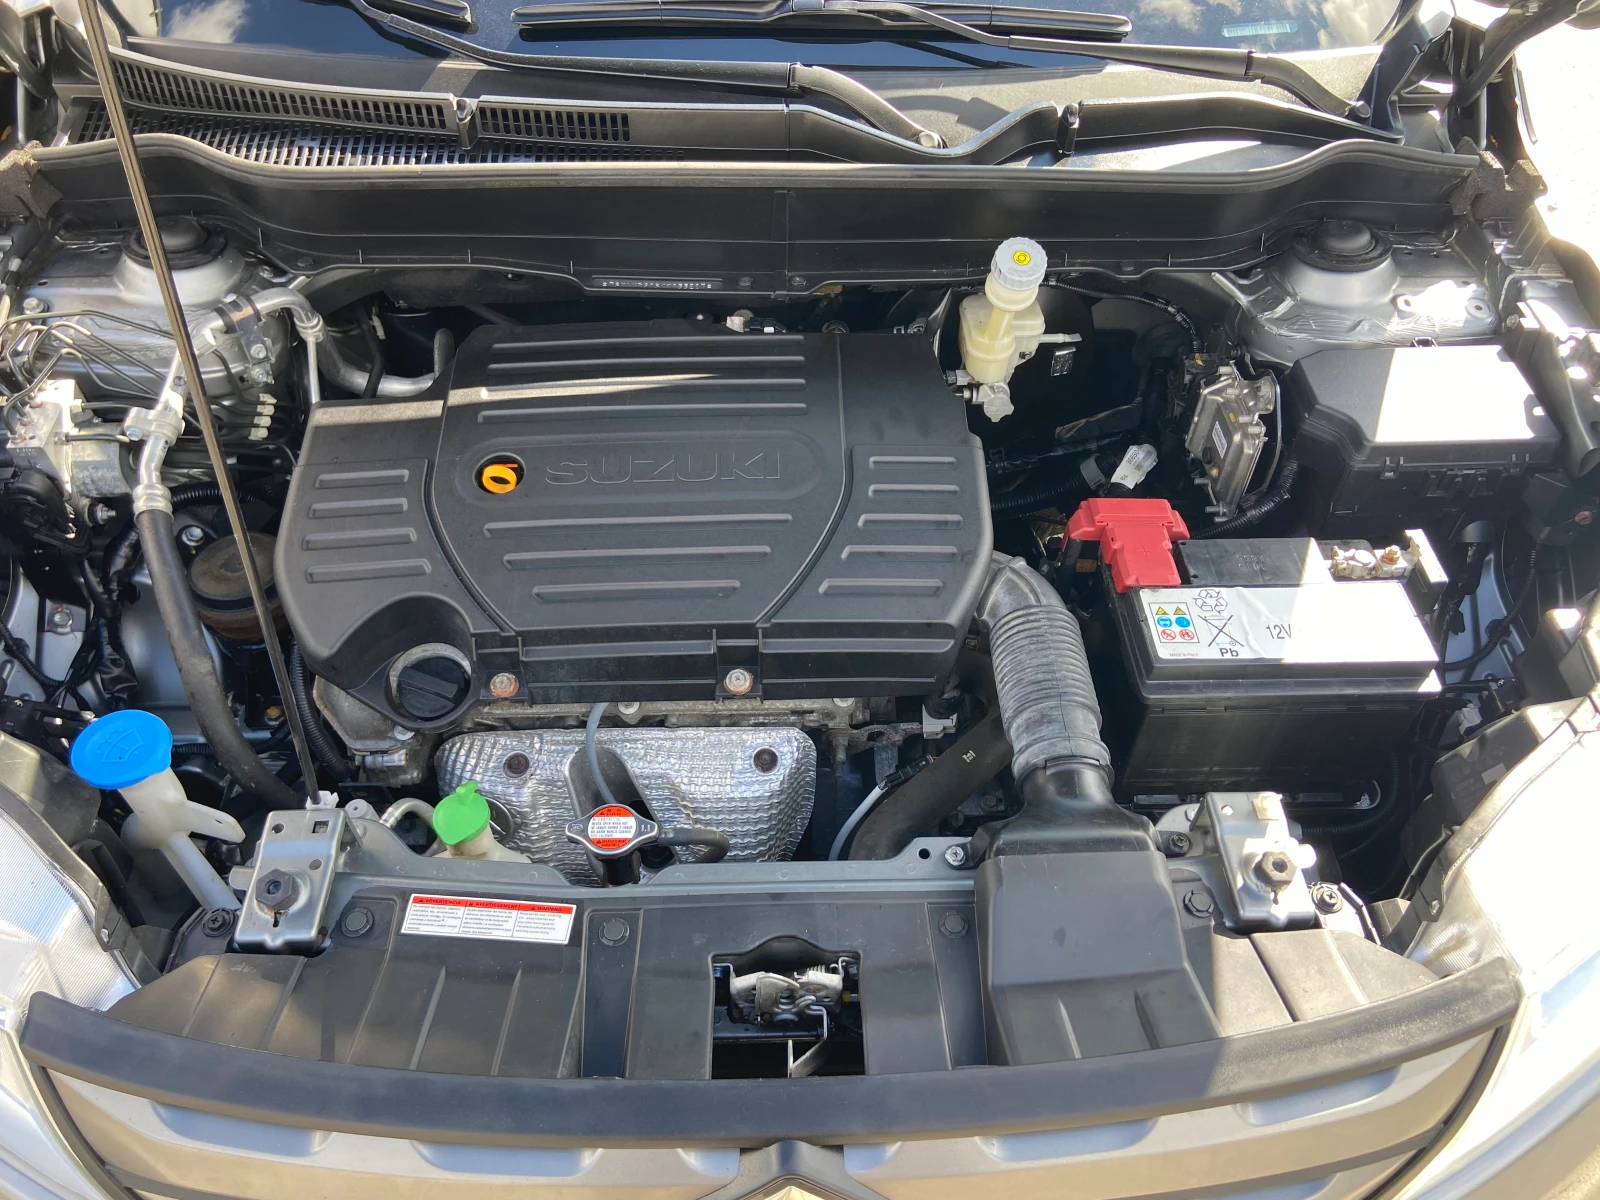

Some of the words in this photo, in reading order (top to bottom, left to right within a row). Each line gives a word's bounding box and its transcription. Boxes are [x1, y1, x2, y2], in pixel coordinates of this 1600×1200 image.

[545, 452, 781, 485] SUZUKI
[1266, 624, 1292, 639] 12V
[1220, 648, 1239, 657] Pb
